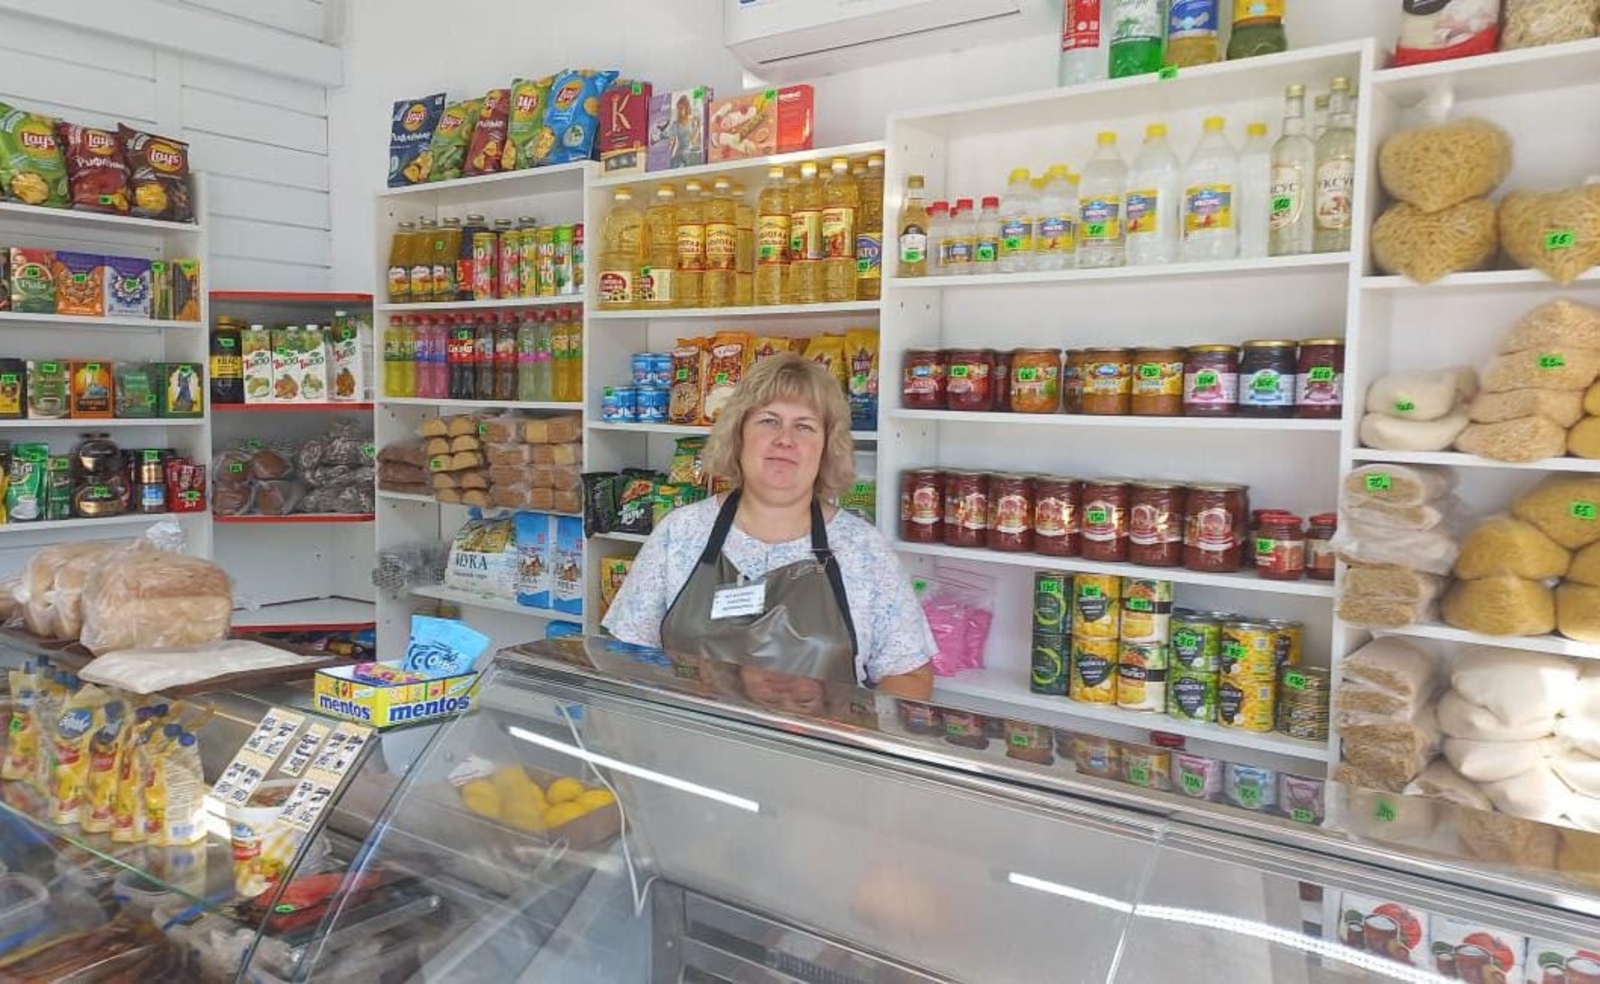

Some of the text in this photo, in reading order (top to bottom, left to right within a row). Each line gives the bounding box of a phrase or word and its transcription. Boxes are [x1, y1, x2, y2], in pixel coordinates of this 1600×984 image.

[23, 131, 56, 150] Lay's
[151, 149, 181, 165] Lay's
[320, 695, 371, 720] mentos
[390, 694, 470, 722] mentos
